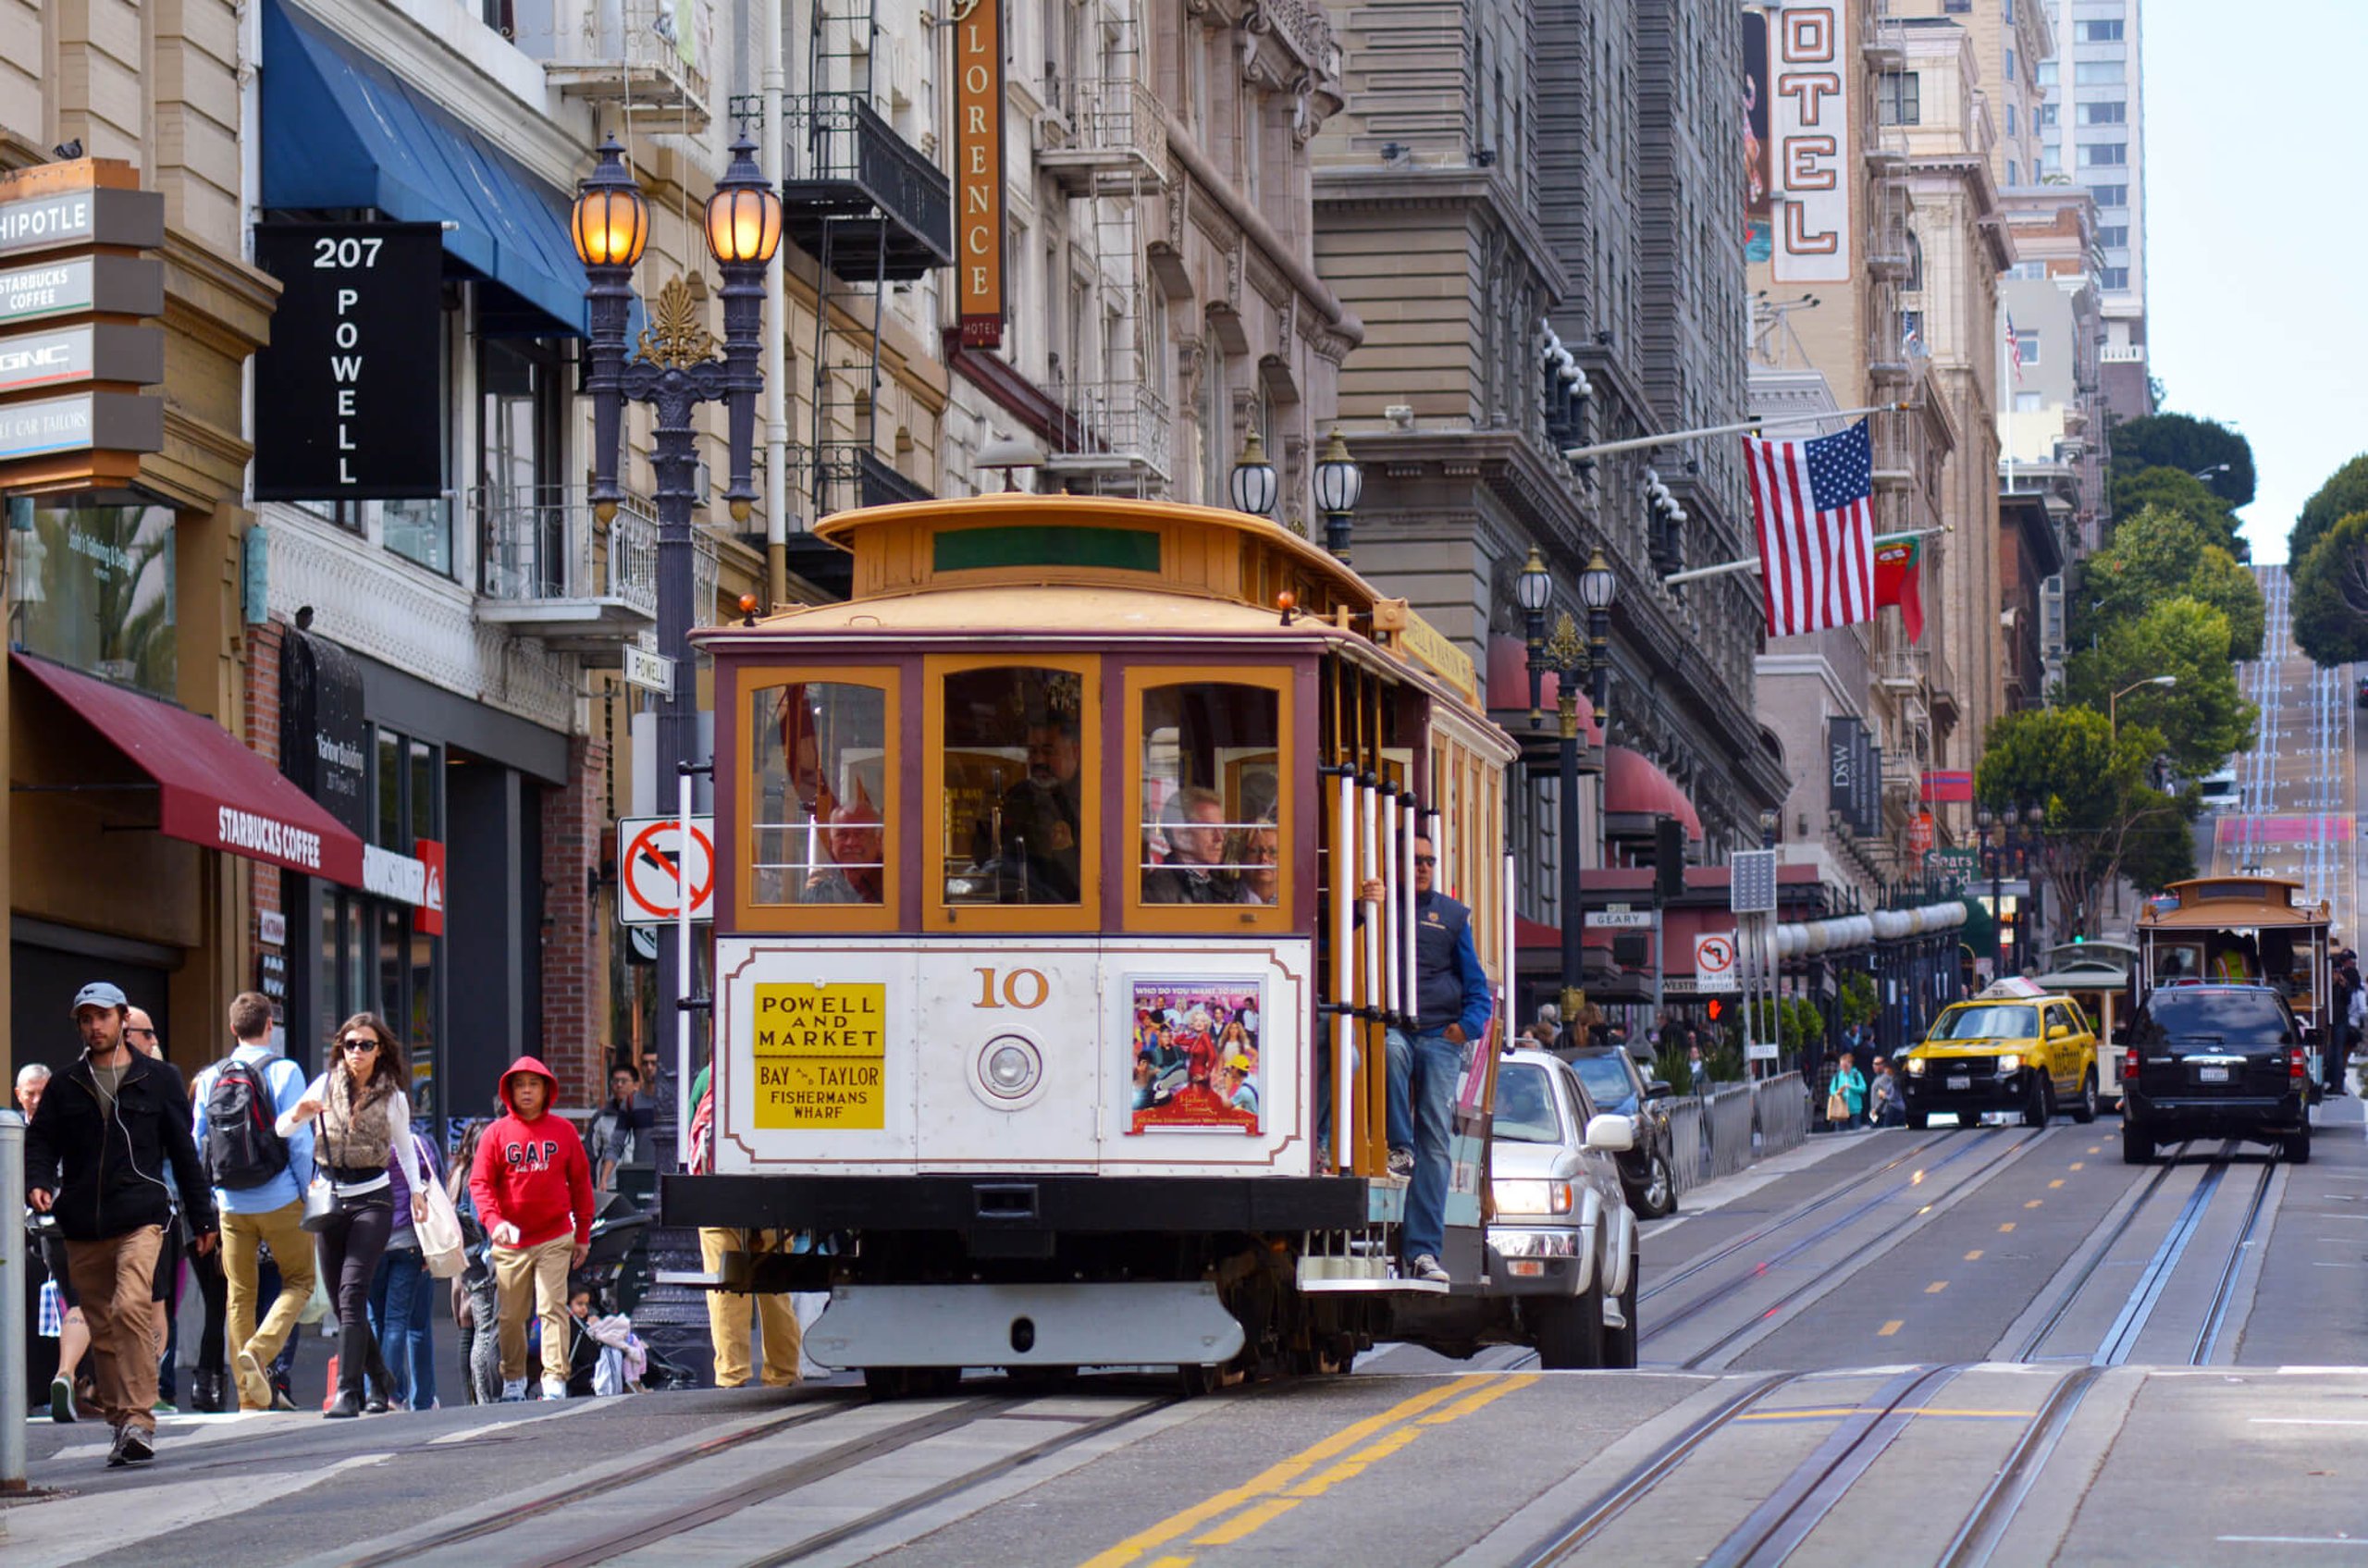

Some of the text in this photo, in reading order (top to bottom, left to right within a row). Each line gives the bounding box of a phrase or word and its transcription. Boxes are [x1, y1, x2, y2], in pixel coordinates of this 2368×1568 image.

[314, 237, 383, 268] 207
[10, 288, 56, 311] COFFEE
[963, 322, 997, 336] HOTEL
[330, 289, 363, 485] POWELL
[635, 655, 666, 685] POWELL
[1834, 743, 1850, 787] DSW
[219, 805, 321, 870] STARBUCKS COFFEE
[1597, 915, 1640, 924] GEARY
[971, 967, 1050, 1009] 10
[1135, 987, 1157, 995] WHO
[1158, 987, 1170, 995] DO
[1172, 987, 1190, 995] YOU
[1190, 987, 1215, 995] WANT
[1217, 987, 1229, 995] TO
[762, 997, 876, 1014] POWELL
[792, 1016, 848, 1029] AND
[759, 1031, 878, 1047] MARKET
[760, 1067, 790, 1086] BAY
[819, 1067, 879, 1086] TAYLOR
[771, 1092, 868, 1105] FISHERMANS
[795, 1106, 845, 1119] WHARF
[506, 1141, 558, 1164] GAP
